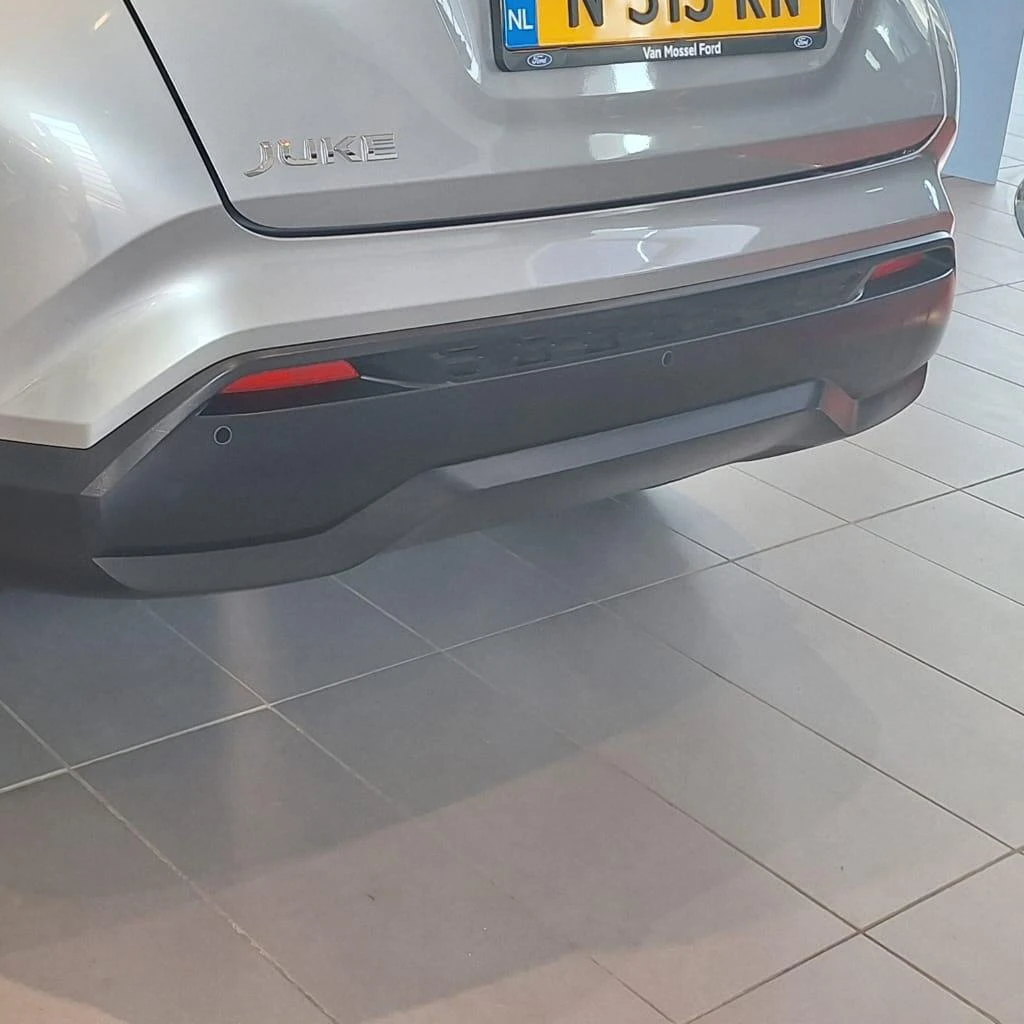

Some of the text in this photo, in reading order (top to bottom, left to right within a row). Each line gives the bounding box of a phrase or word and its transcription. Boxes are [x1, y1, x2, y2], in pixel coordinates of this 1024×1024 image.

[507, 7, 533, 31] NL
[642, 41, 722, 60] Van Mossel Ford
[243, 132, 398, 178] JUKE
